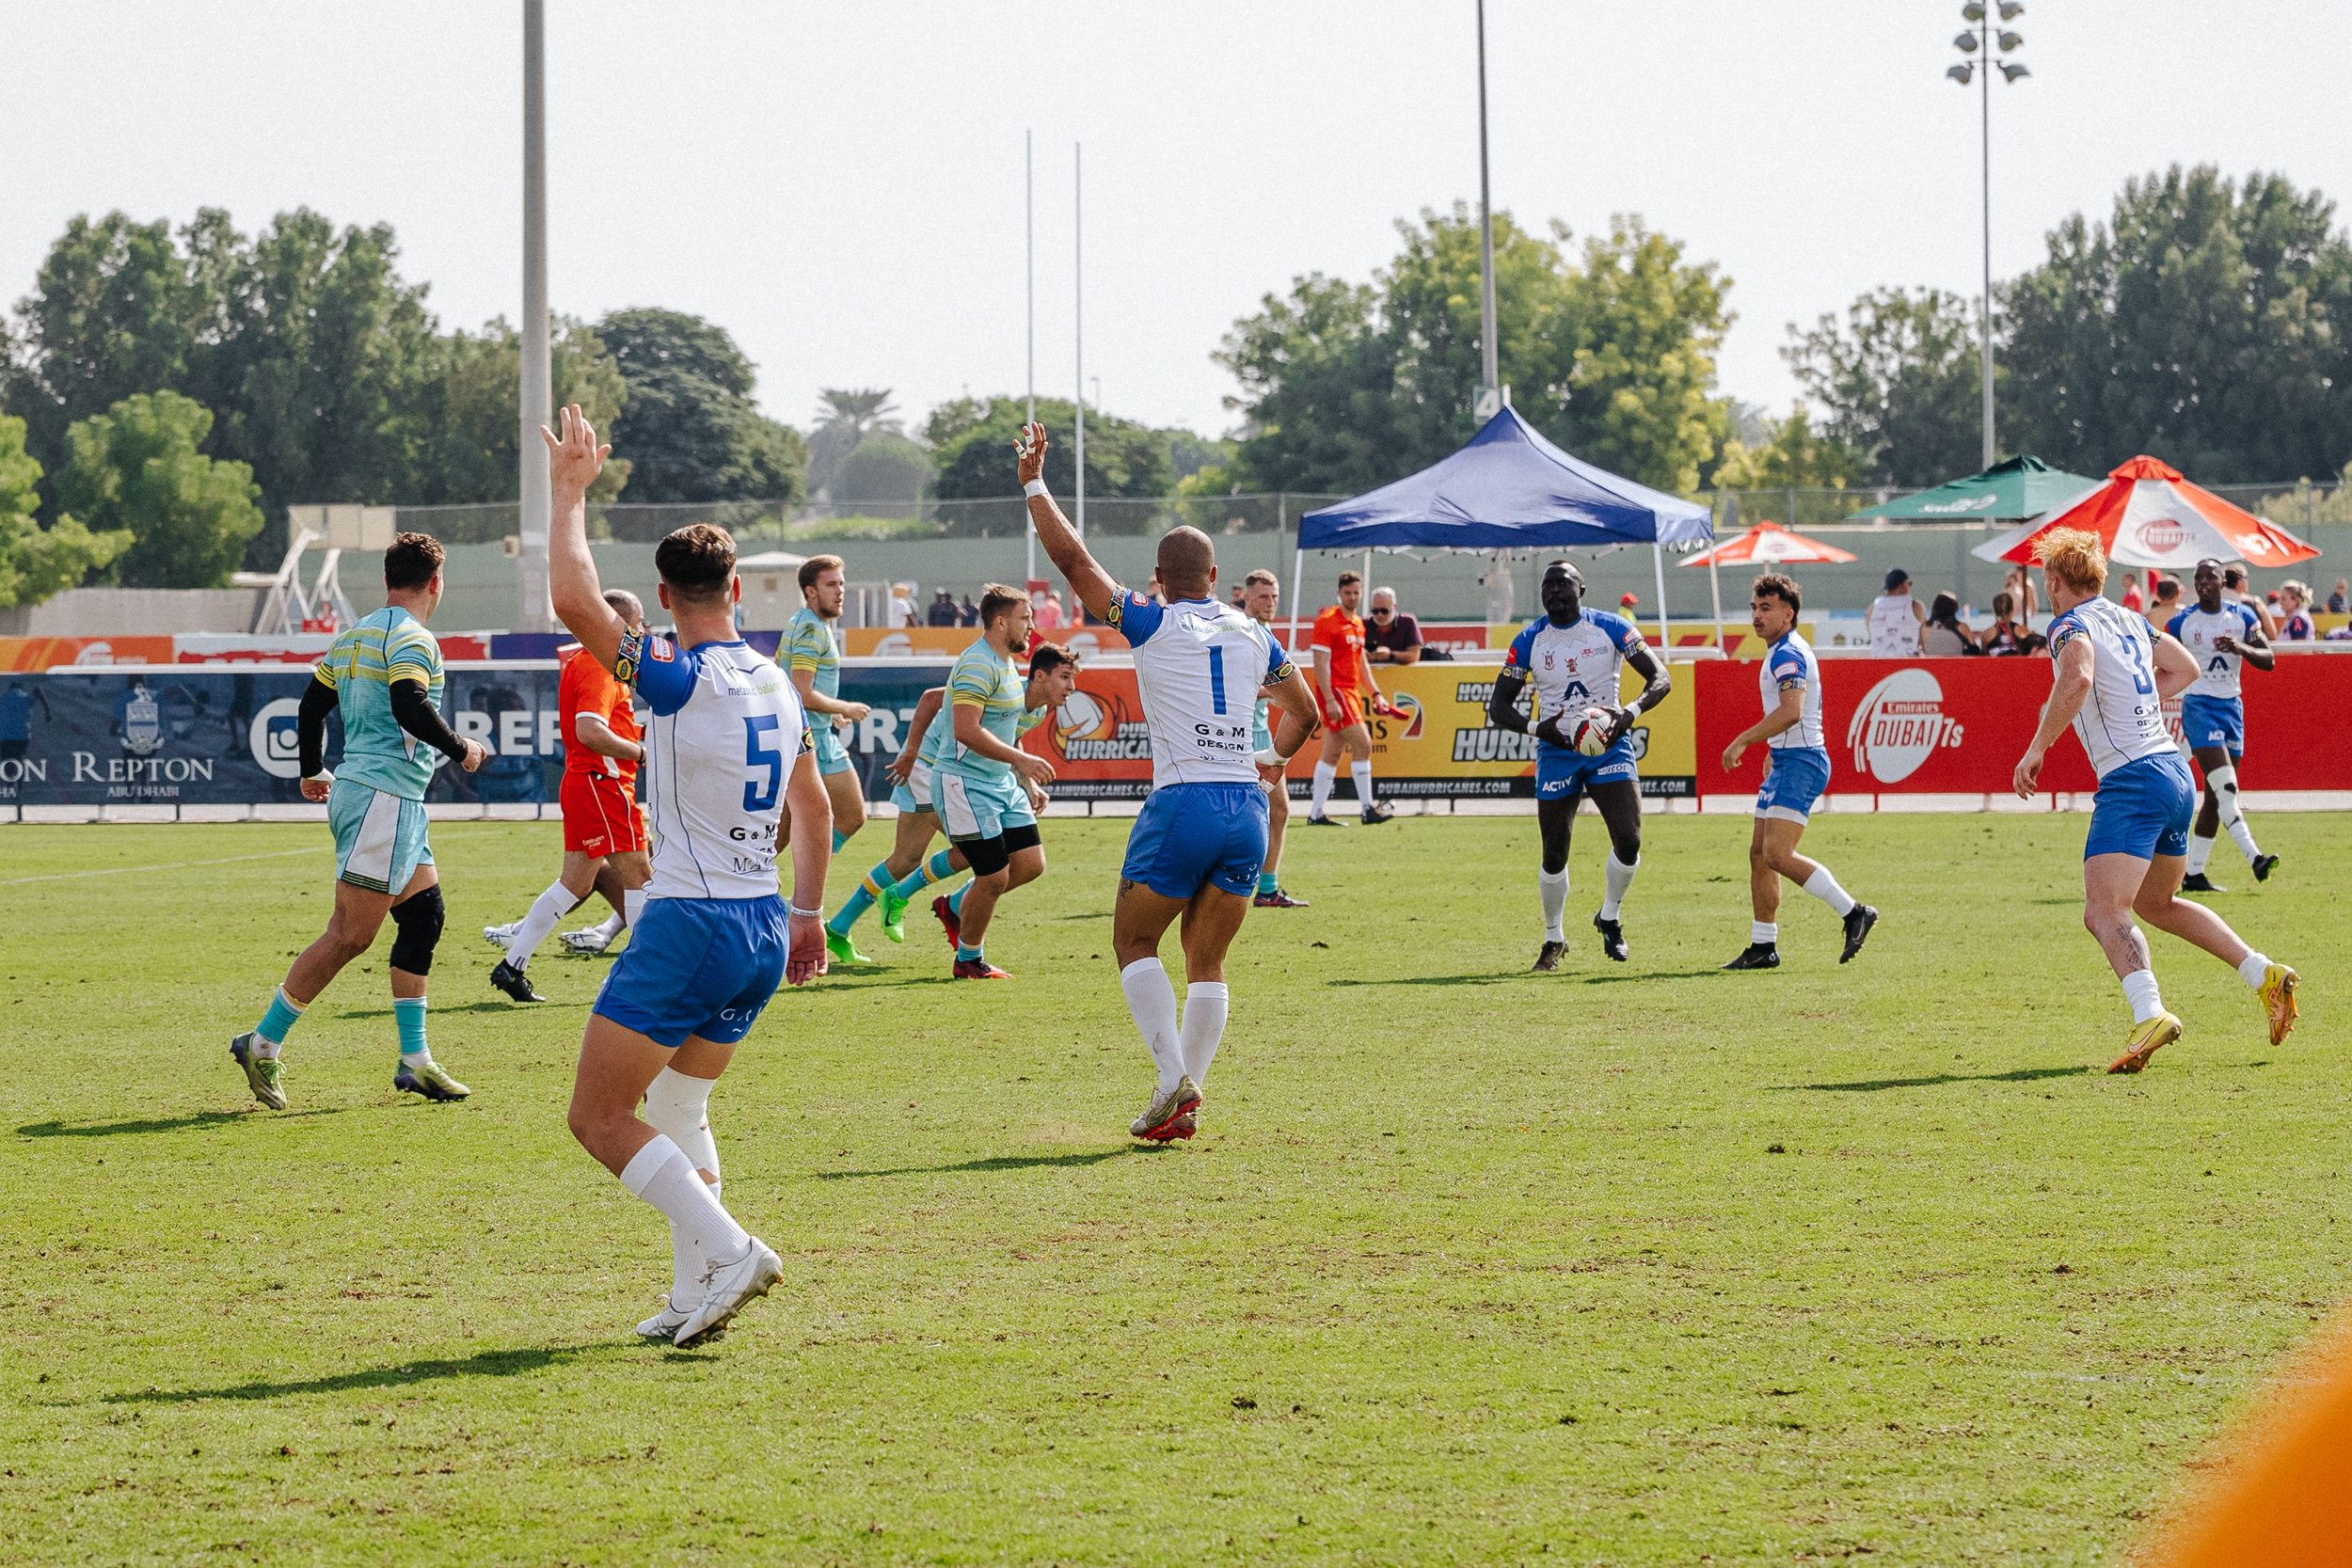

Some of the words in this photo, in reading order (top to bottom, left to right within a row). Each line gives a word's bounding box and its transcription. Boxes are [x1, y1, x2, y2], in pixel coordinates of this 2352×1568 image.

[1475, 388, 1501, 420] 4
[2116, 635, 2153, 694] 3
[1205, 645, 1227, 715] 1
[1457, 683, 1496, 702] HOM
[1887, 702, 1939, 714] Emirates
[1117, 722, 1149, 739] DUB
[1195, 723, 1210, 736] G
[1216, 728, 1225, 736] &
[1232, 726, 1245, 737] M
[1873, 720, 1935, 747] DUBAI
[1940, 718, 1964, 748] 7s
[1065, 739, 1152, 760] HURRICA
[1197, 738, 1245, 752] DESIGN
[72, 752, 215, 783] REPTON
[742, 713, 782, 813] 5
[107, 786, 135, 798] ABU
[136, 786, 180, 798] DHABI
[1376, 782, 1511, 795] DUBAIHURRICANES.COM
[1542, 776, 1573, 793] ACTIV
[729, 826, 746, 841] G
